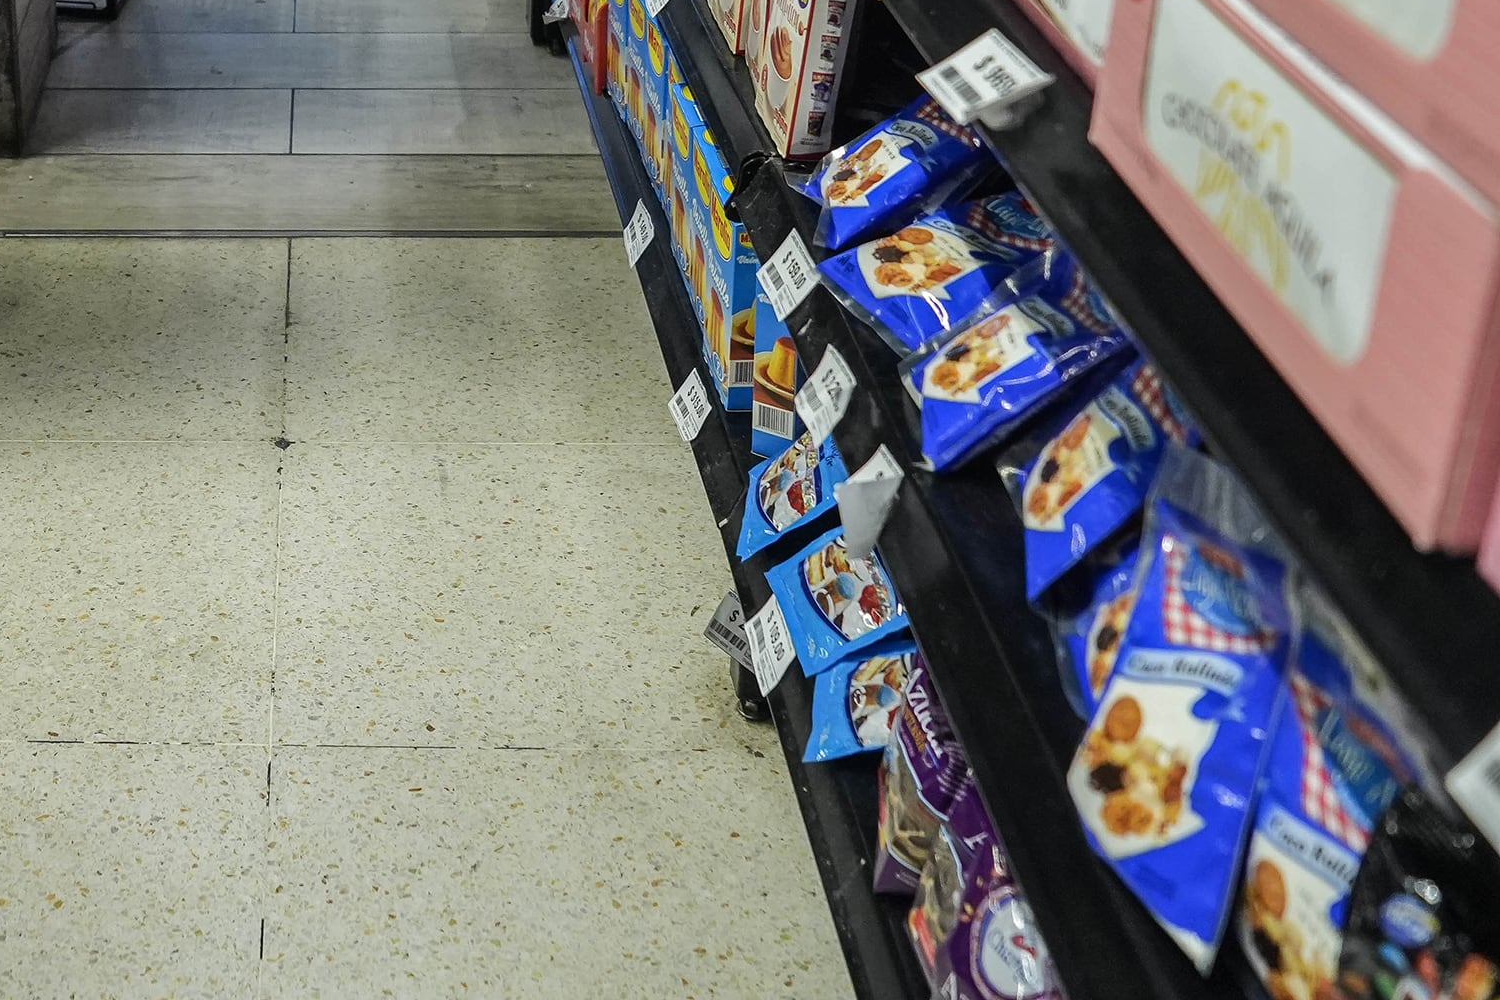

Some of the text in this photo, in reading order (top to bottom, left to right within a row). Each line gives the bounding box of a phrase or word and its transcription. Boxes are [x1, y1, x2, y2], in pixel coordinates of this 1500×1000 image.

[786, 259, 808, 290] 159.00
[690, 392, 705, 420] 315.00
[728, 609, 740, 622] $
[768, 621, 786, 662] 109.00
